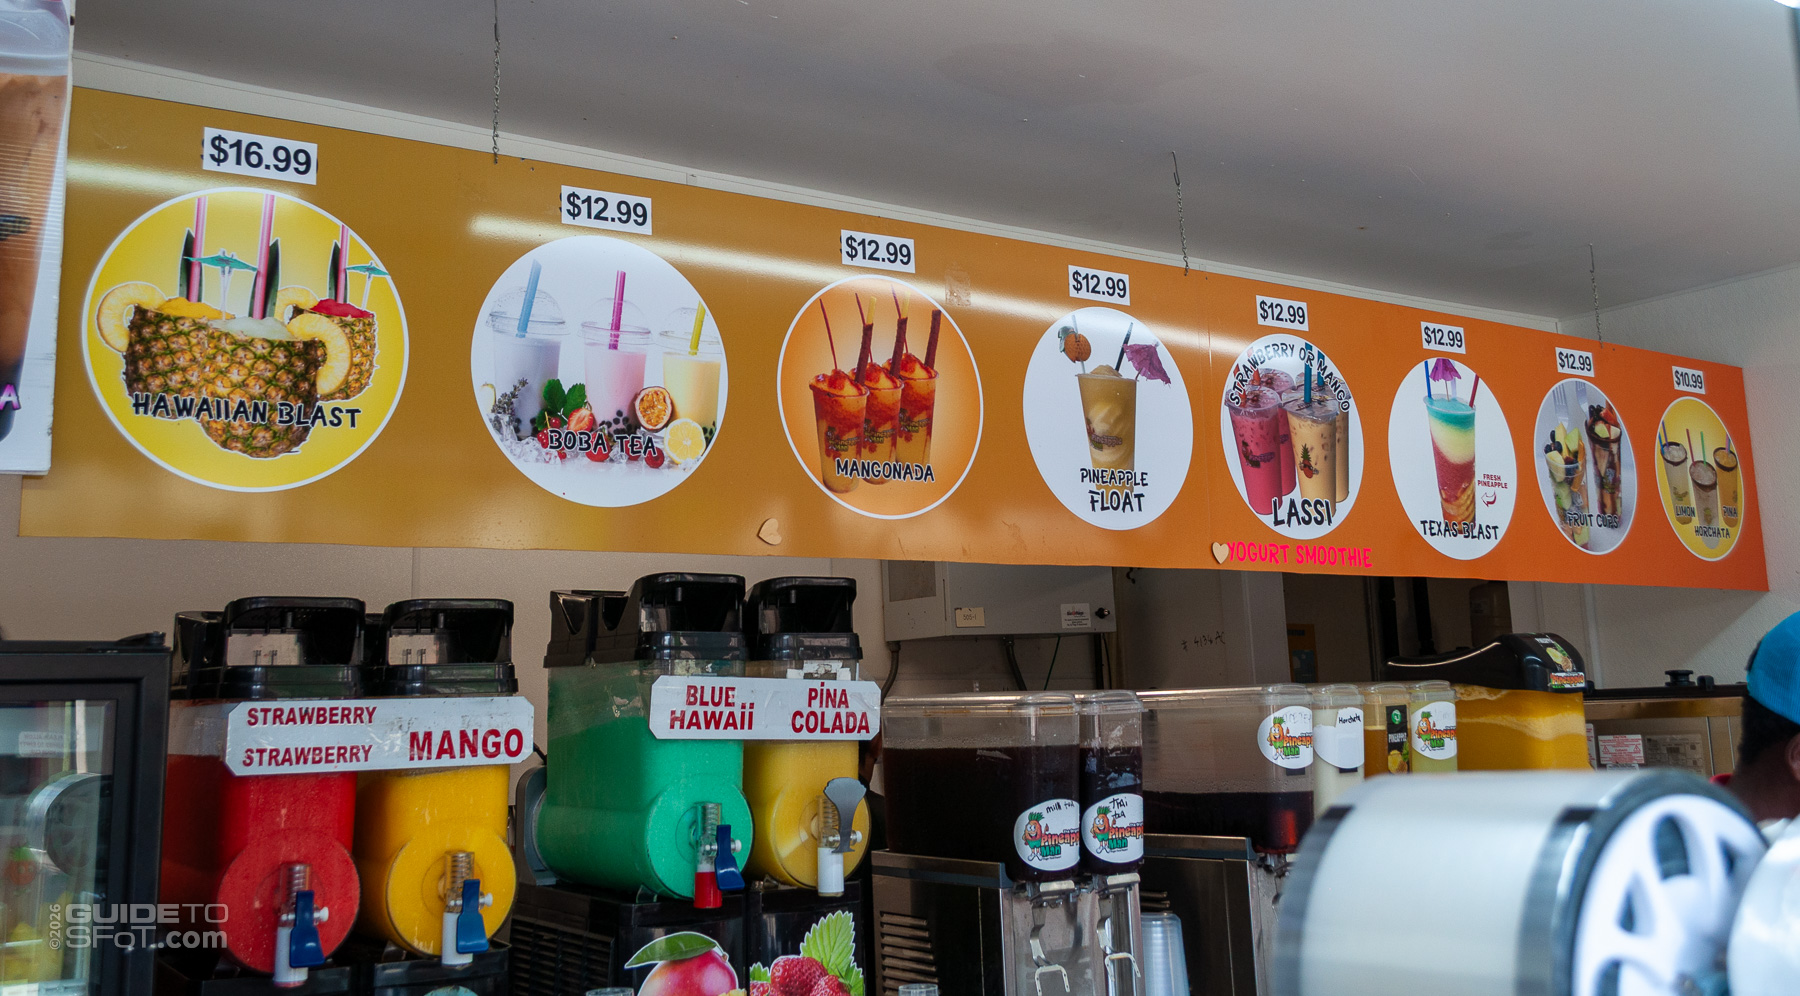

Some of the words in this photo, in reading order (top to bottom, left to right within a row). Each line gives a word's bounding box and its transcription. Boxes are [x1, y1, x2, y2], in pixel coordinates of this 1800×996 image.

[209, 134, 312, 176] $16.99
[566, 191, 648, 226] $12.99
[845, 235, 911, 265] $12.99
[1072, 270, 1127, 298] $12.99
[1259, 300, 1305, 325] $12.99
[1424, 326, 1463, 348] $12.99
[1558, 351, 1592, 372] $12.99
[1229, 343, 1295, 406] STRAWBERRY
[1299, 347, 1315, 367] OR
[1317, 358, 1350, 412] MANGO
[1674, 369, 1703, 390] $10.99
[132, 393, 267, 425] HAWAIIAN
[277, 402, 361, 428] BLAST
[549, 429, 607, 453] BOBA
[615, 434, 656, 456] TEA
[836, 458, 935, 482] MANGONADA
[1080, 467, 1149, 487] PINEAPPLE
[1483, 473, 1502, 482] FRESH
[1477, 480, 1508, 489] PINEAPPLE
[1088, 489, 1145, 513] FLOAT
[1272, 498, 1333, 527] LASSI
[1675, 505, 1696, 518] LIMON
[1420, 520, 1458, 538] TEXAS
[1462, 522, 1499, 540] BLAST
[1567, 512, 1593, 527] FRUIT
[1596, 514, 1619, 529] CUPS
[1694, 525, 1731, 539] HORCHATA
[1227, 541, 1290, 565] YOGURT
[1296, 545, 1372, 568] SMOOTHIE
[685, 685, 736, 708] BLUE
[247, 706, 377, 726] STRAWBERRY
[791, 711, 870, 734] COLADA
[242, 745, 373, 767] STRAWBERRY
[409, 728, 524, 762] MANGO
[1041, 845, 1061, 857] Man
[1108, 838, 1128, 850] Man
